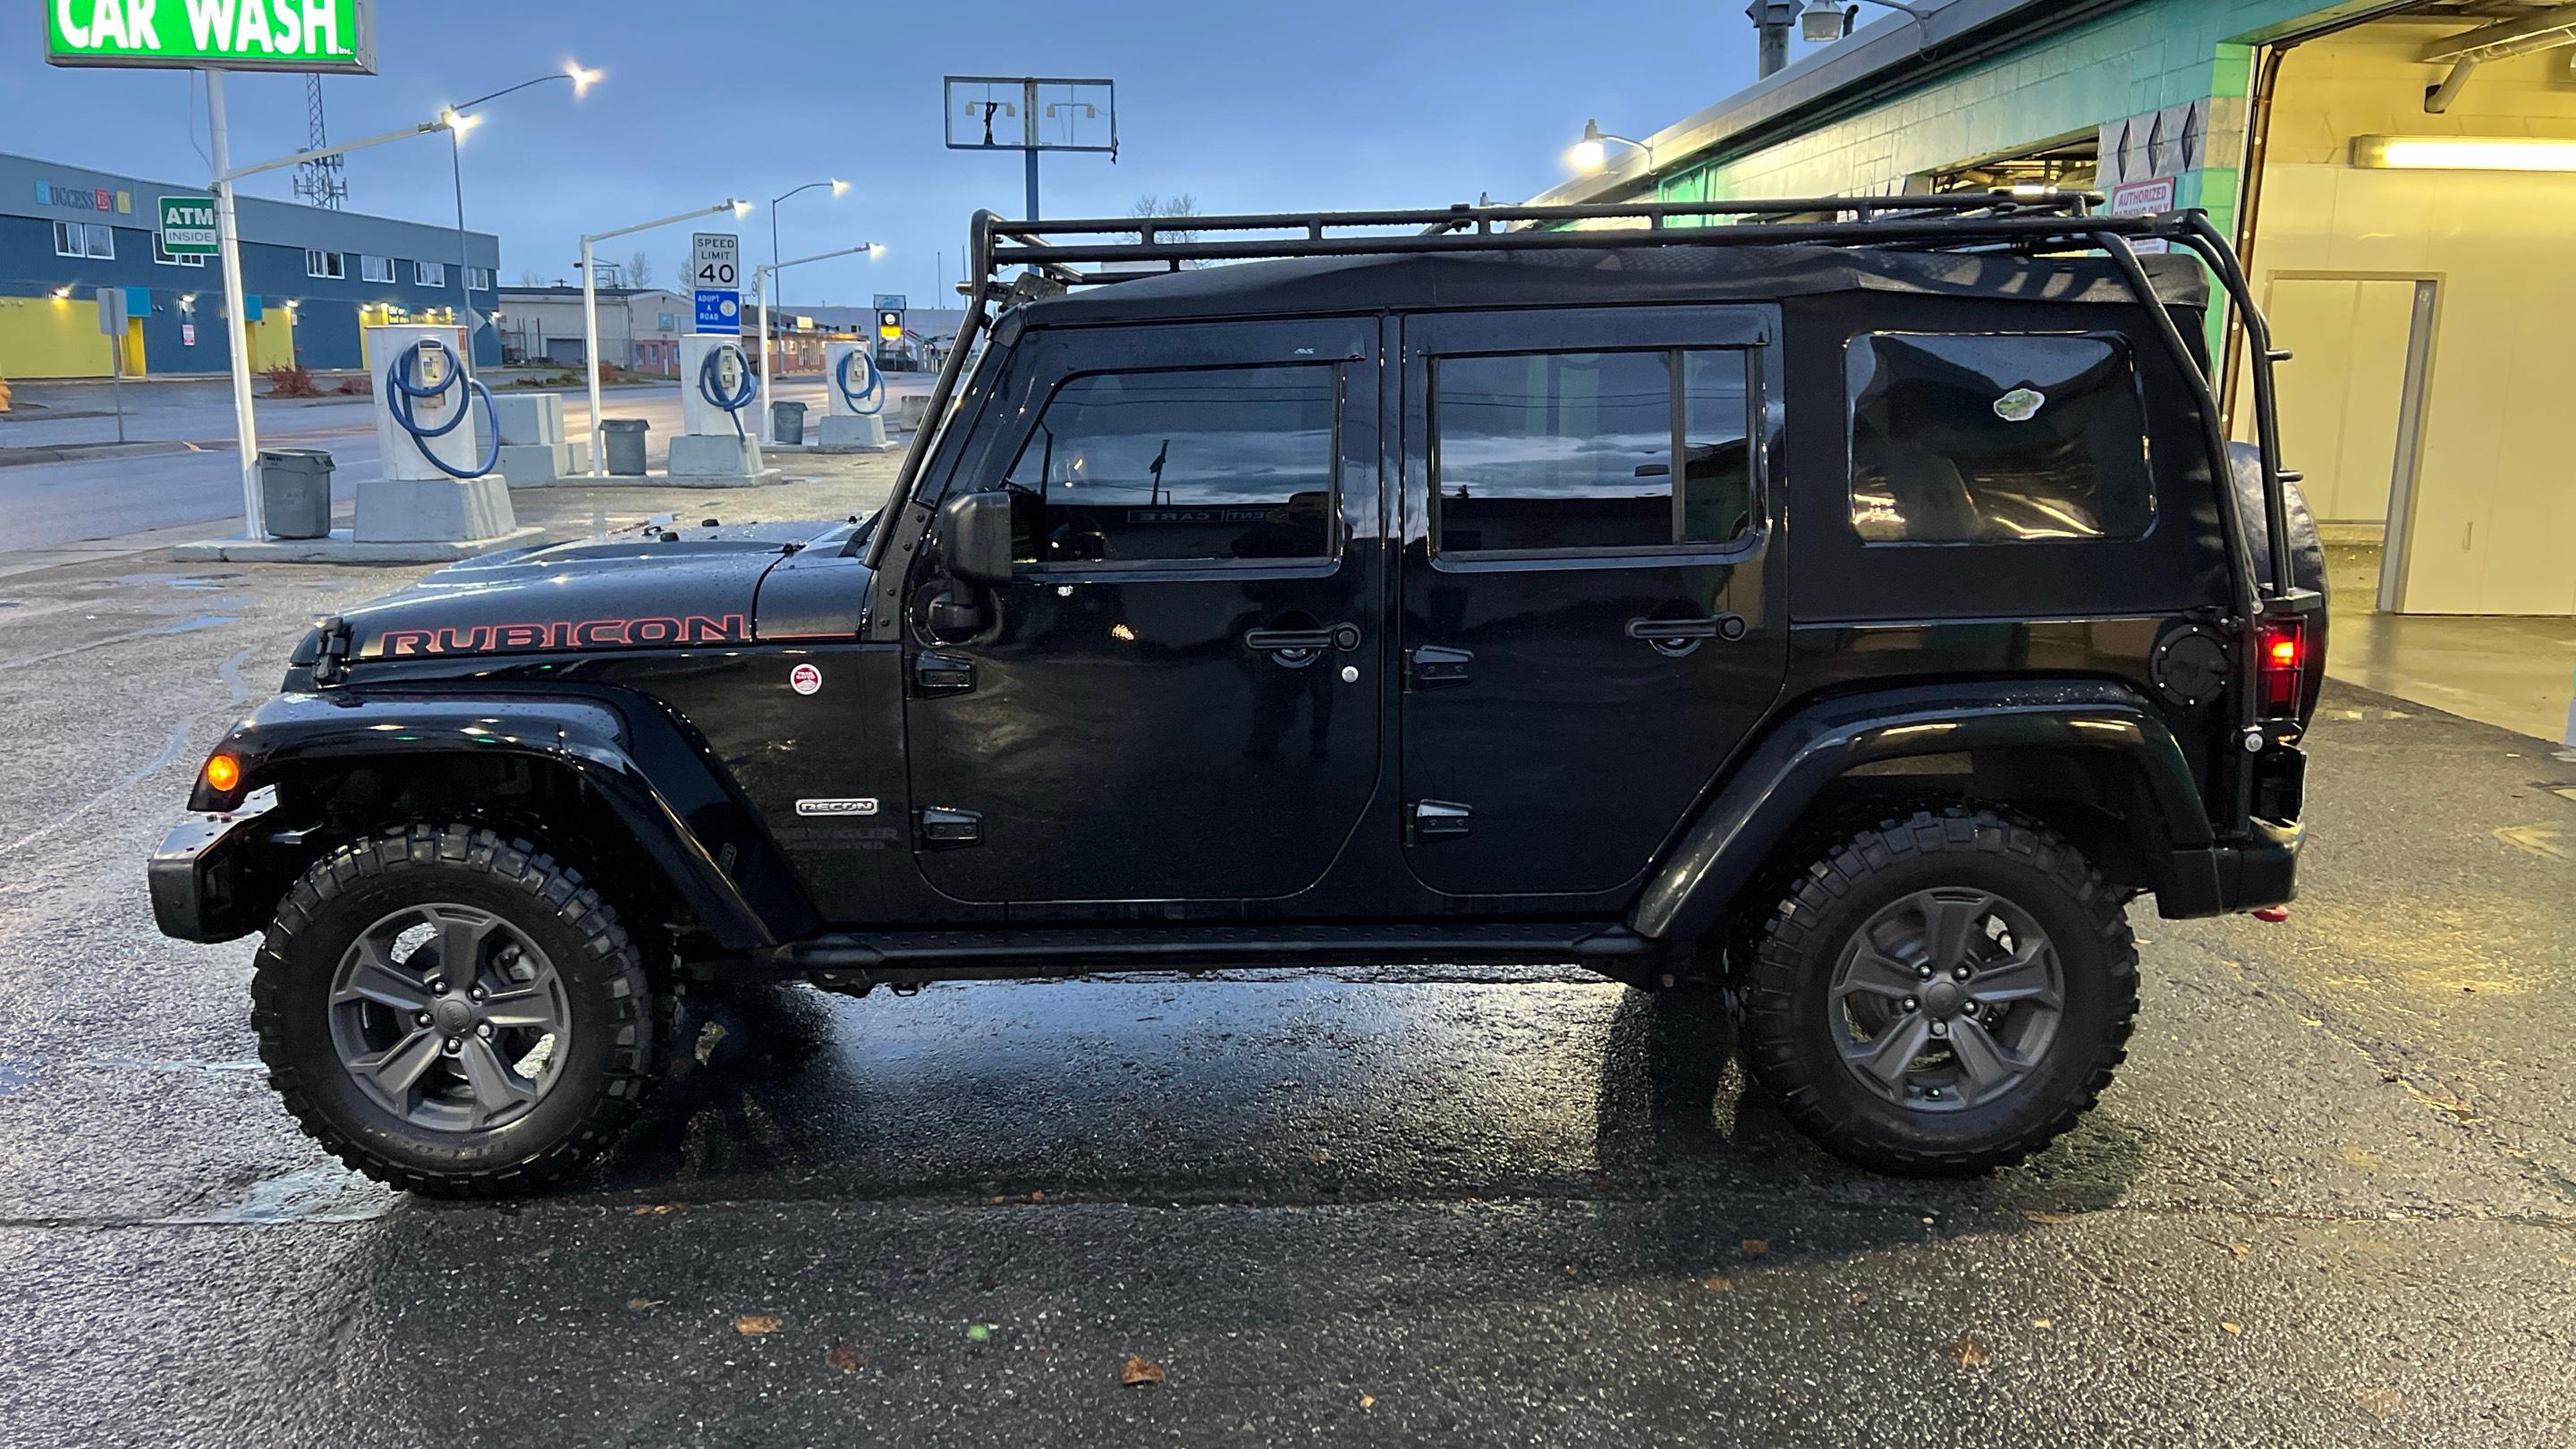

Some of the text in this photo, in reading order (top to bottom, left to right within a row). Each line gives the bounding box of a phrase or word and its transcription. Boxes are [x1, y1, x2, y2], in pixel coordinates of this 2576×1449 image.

[57, 0, 337, 55] CAR WASH
[338, 47, 354, 55] Inc.
[2118, 186, 2166, 207] AUTHORIZED
[165, 207, 214, 225] ATM
[168, 232, 213, 242] INSIDE
[697, 238, 734, 249] SPEED
[701, 251, 730, 260] LIMIT
[699, 263, 734, 283] 40
[698, 294, 720, 302] ADOPT
[699, 312, 719, 320] ROAD
[380, 614, 747, 656] RUBICON
[801, 801, 873, 812] RECON
